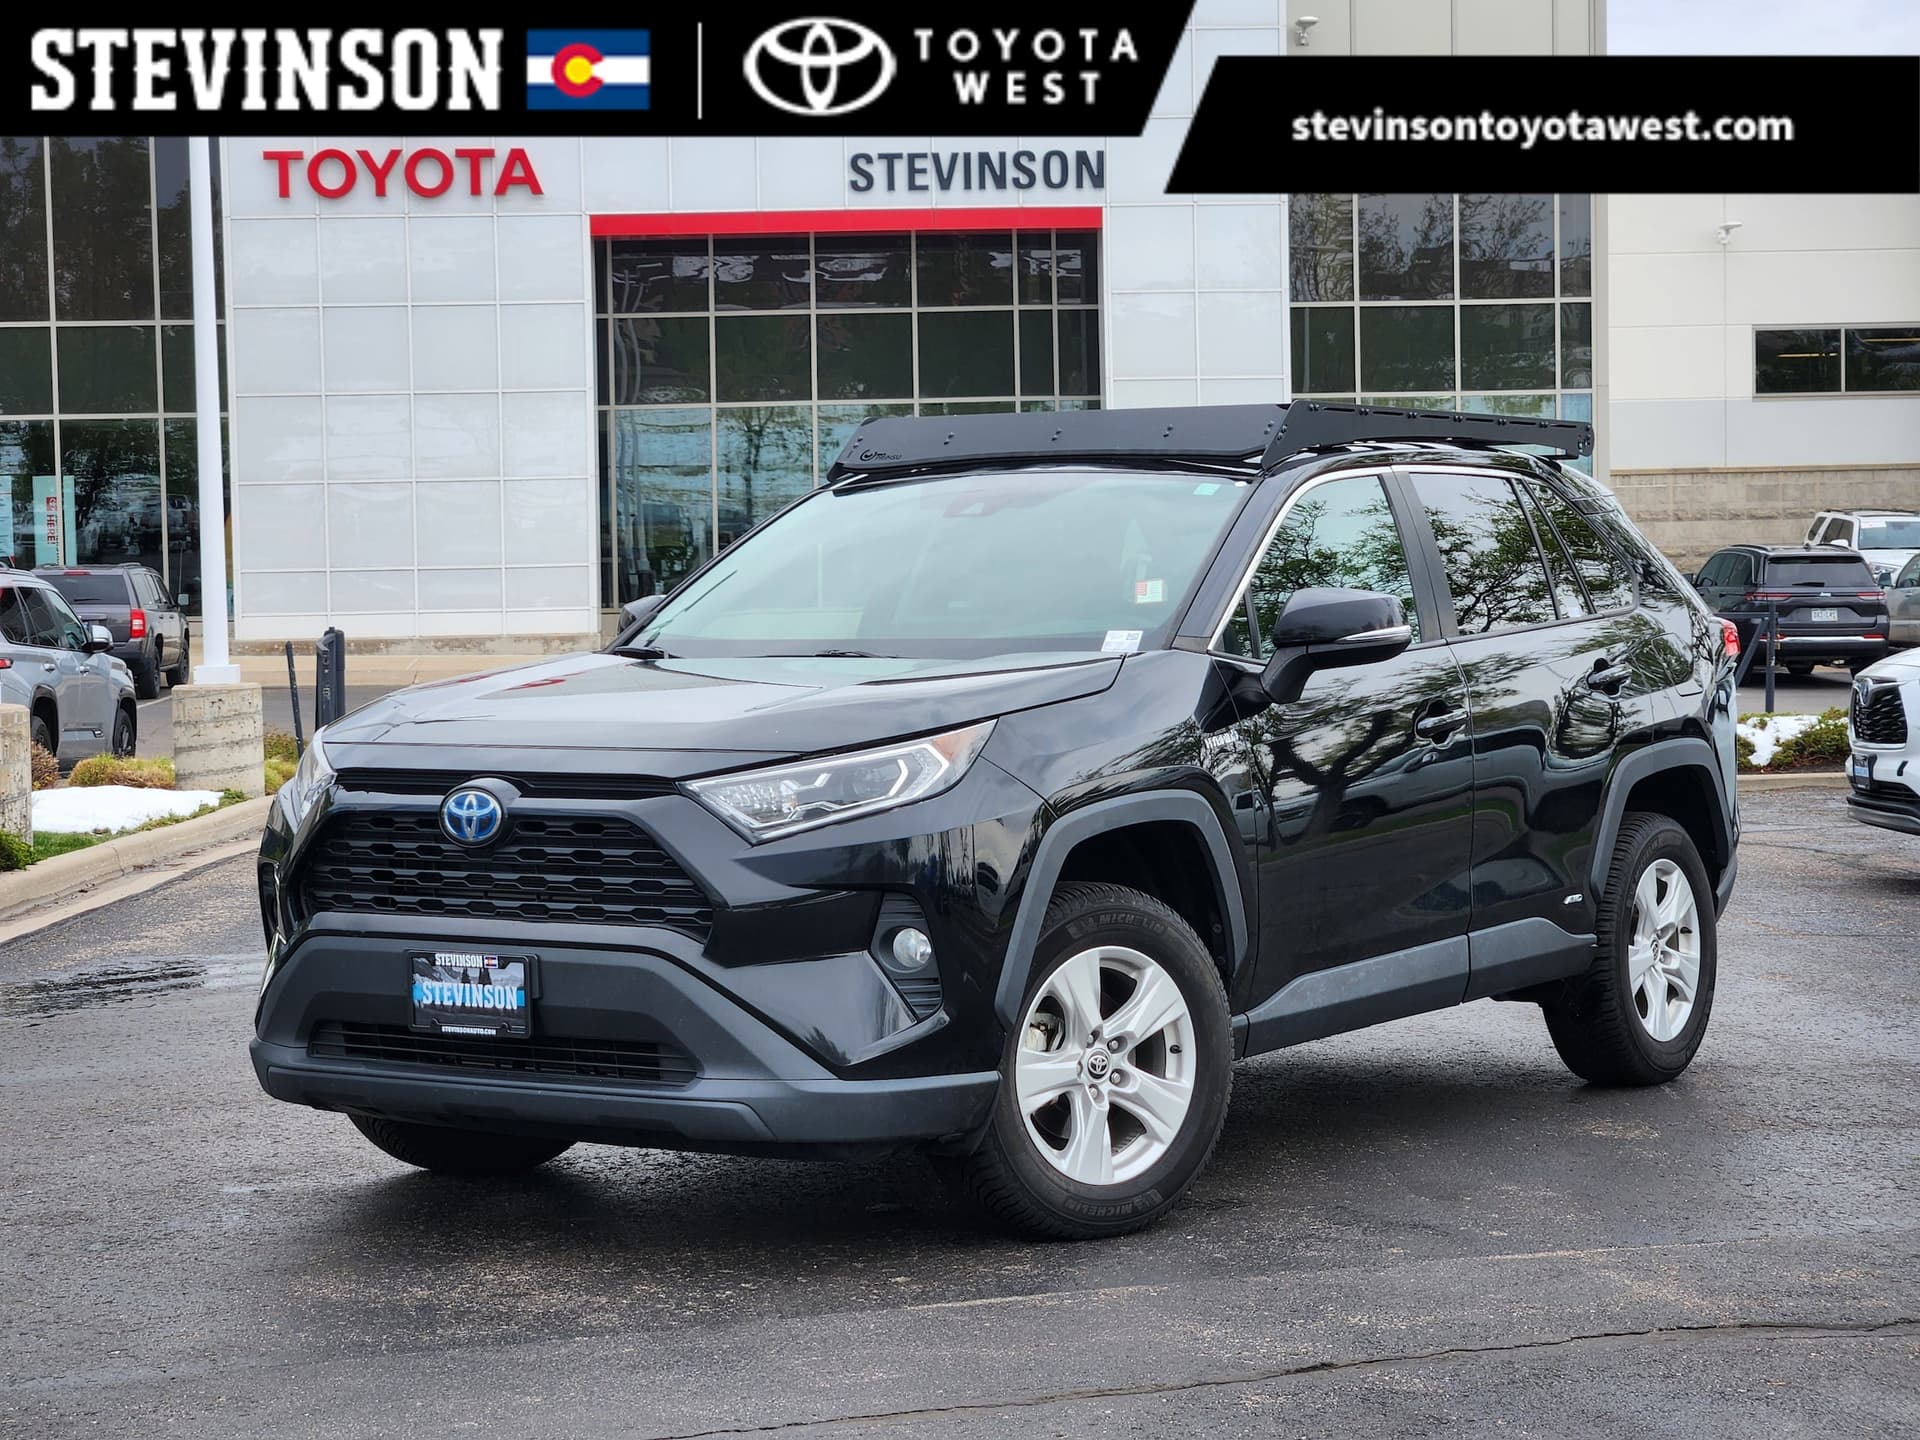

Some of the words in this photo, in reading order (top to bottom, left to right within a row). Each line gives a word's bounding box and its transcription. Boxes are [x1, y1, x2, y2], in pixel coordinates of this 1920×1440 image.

[264, 148, 544, 199] TOYOTA
[849, 150, 1105, 192] STEVINSON
[435, 953, 483, 967] STEVINSON
[422, 982, 518, 1010] STEVINSON
[441, 1026, 497, 1035] STEVINSONAUTO.COM
